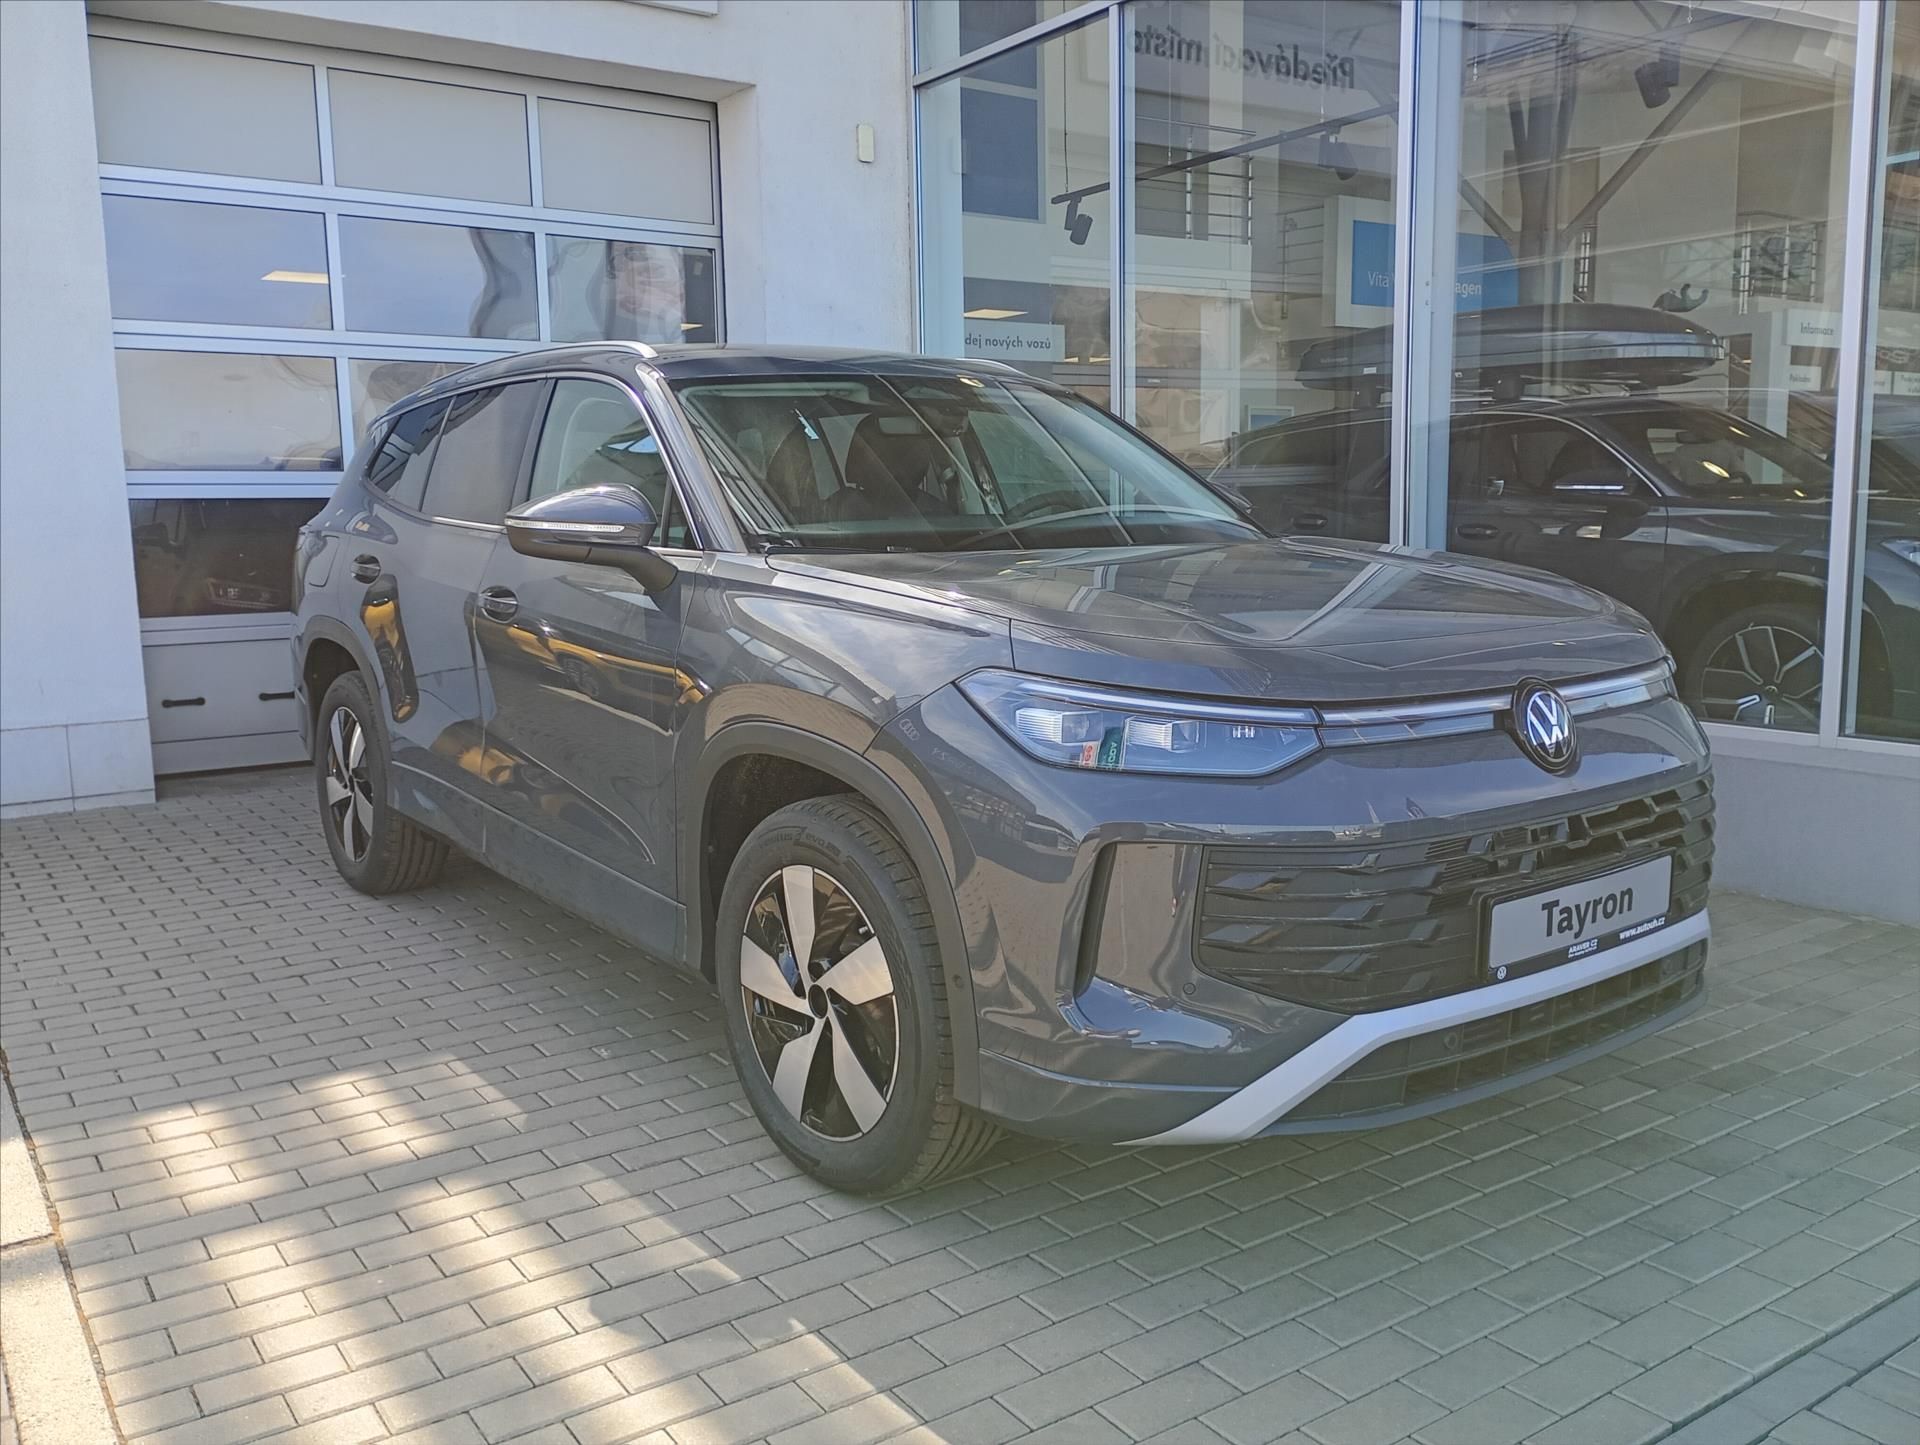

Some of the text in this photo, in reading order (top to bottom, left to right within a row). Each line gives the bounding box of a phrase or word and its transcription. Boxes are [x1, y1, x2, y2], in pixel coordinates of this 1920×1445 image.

[985, 336, 1023, 350] nových
[1026, 337, 1051, 350] vozů
[1541, 887, 1633, 939] Tayron
